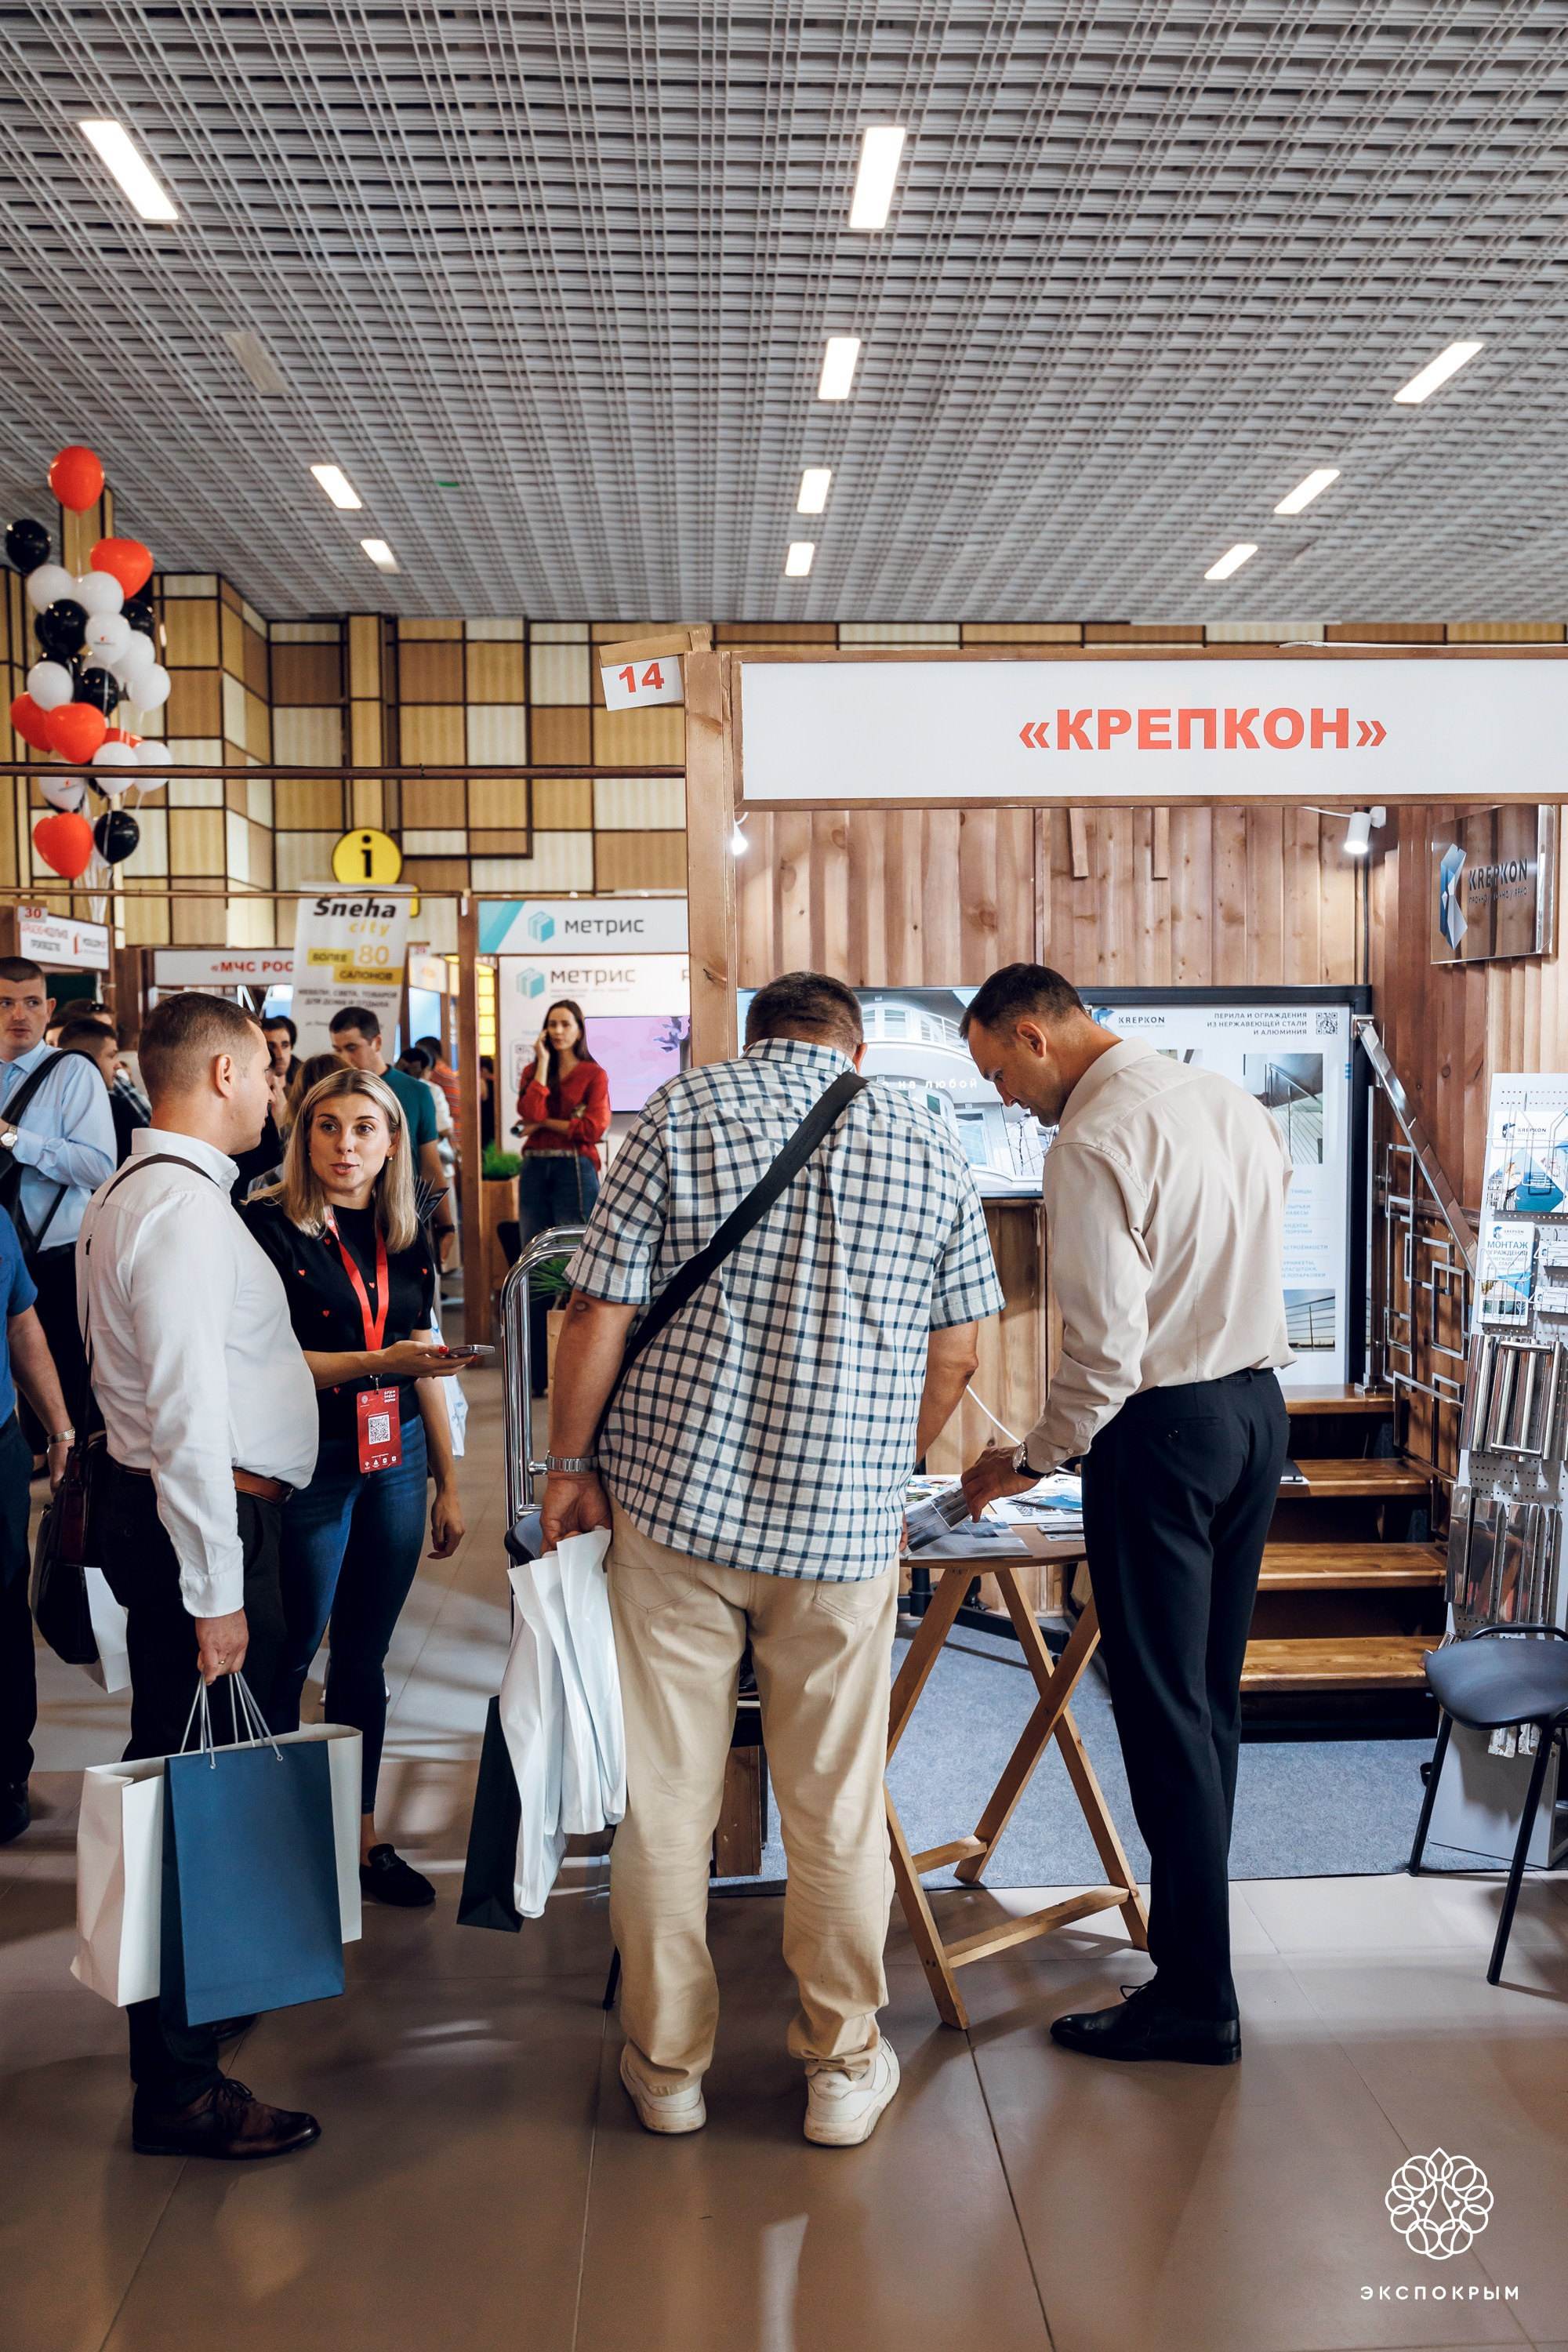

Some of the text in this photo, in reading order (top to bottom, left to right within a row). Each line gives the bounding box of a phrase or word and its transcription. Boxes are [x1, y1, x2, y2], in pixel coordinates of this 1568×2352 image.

[619, 662, 665, 693] 14
[1018, 707, 1388, 750] «КРЕПКОН»
[1469, 858, 1527, 891] KREPKON
[24, 907, 42, 918] 30
[313, 898, 397, 918] Sneha
[350, 919, 390, 936] city
[358, 945, 389, 965] 80
[211, 961, 294, 973] «МЧС РОС
[339, 969, 394, 979] САЛОНОВ
[898, 1080, 916, 1090] на
[924, 1078, 978, 1090] любой
